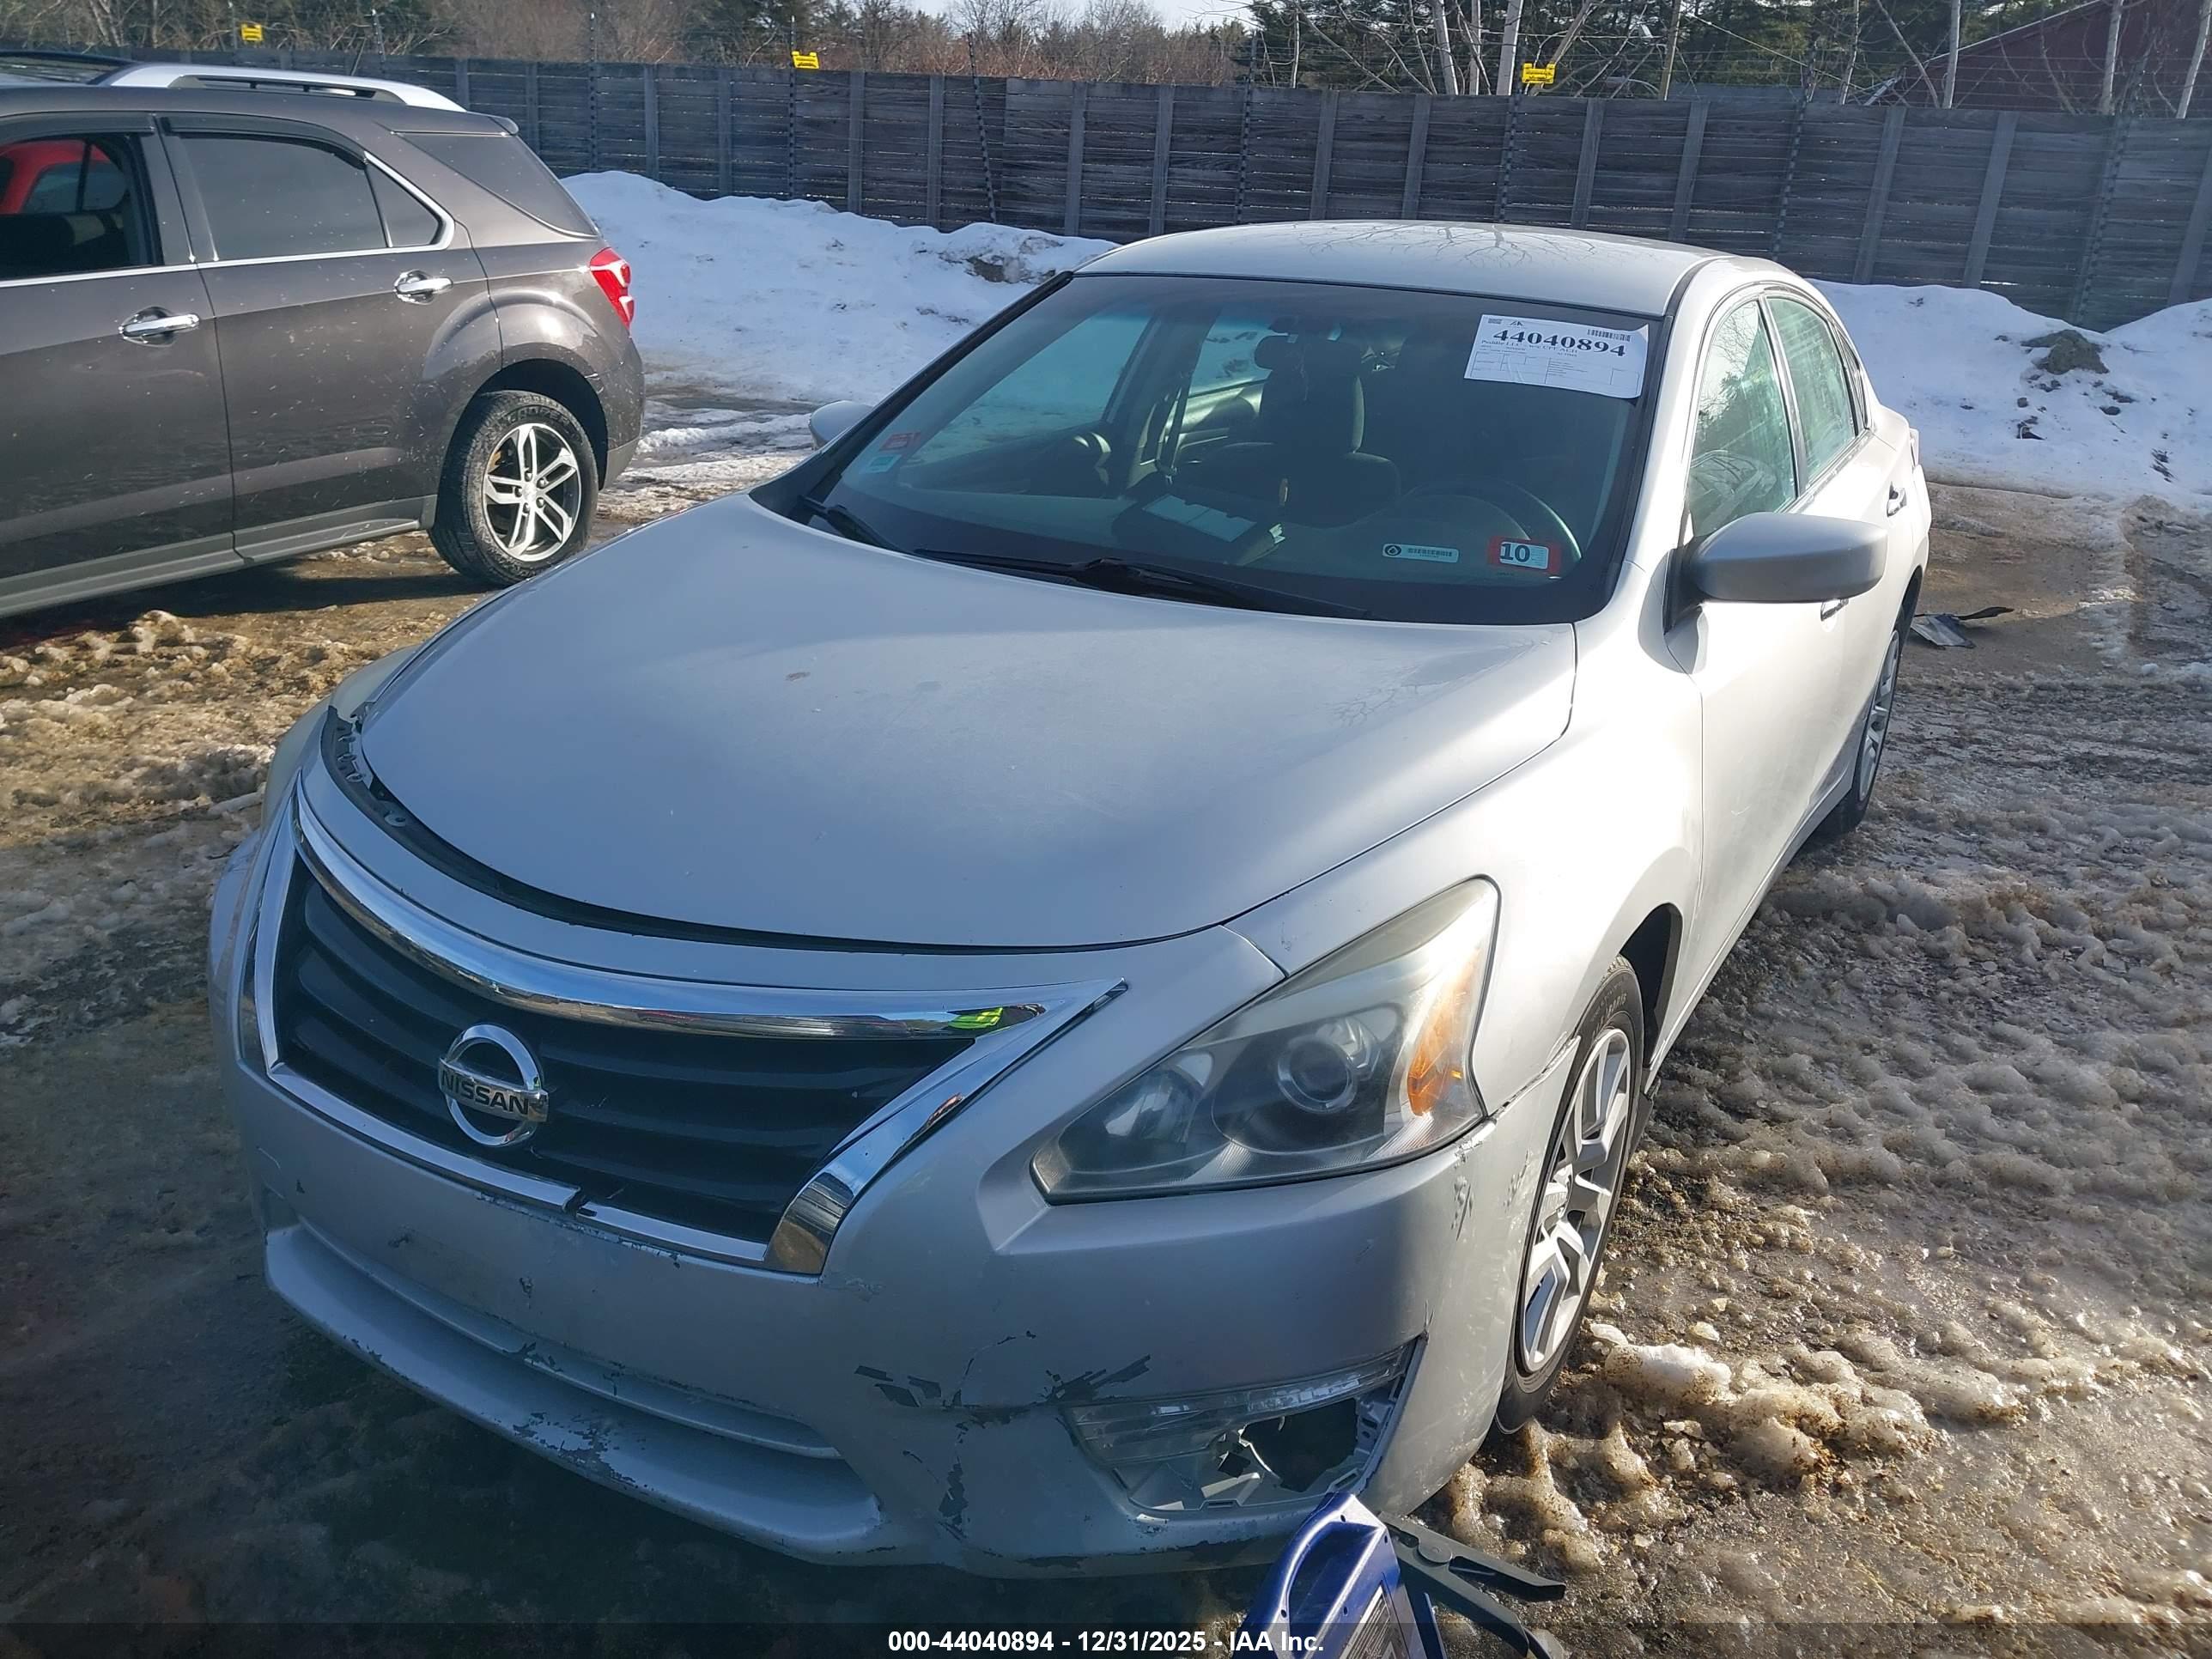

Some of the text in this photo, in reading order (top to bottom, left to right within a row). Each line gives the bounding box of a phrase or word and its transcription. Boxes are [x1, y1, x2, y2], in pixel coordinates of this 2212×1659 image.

[1492, 329, 1626, 358] 44040894
[1499, 543, 1530, 562] 10
[441, 1070, 529, 1115] NISSAN
